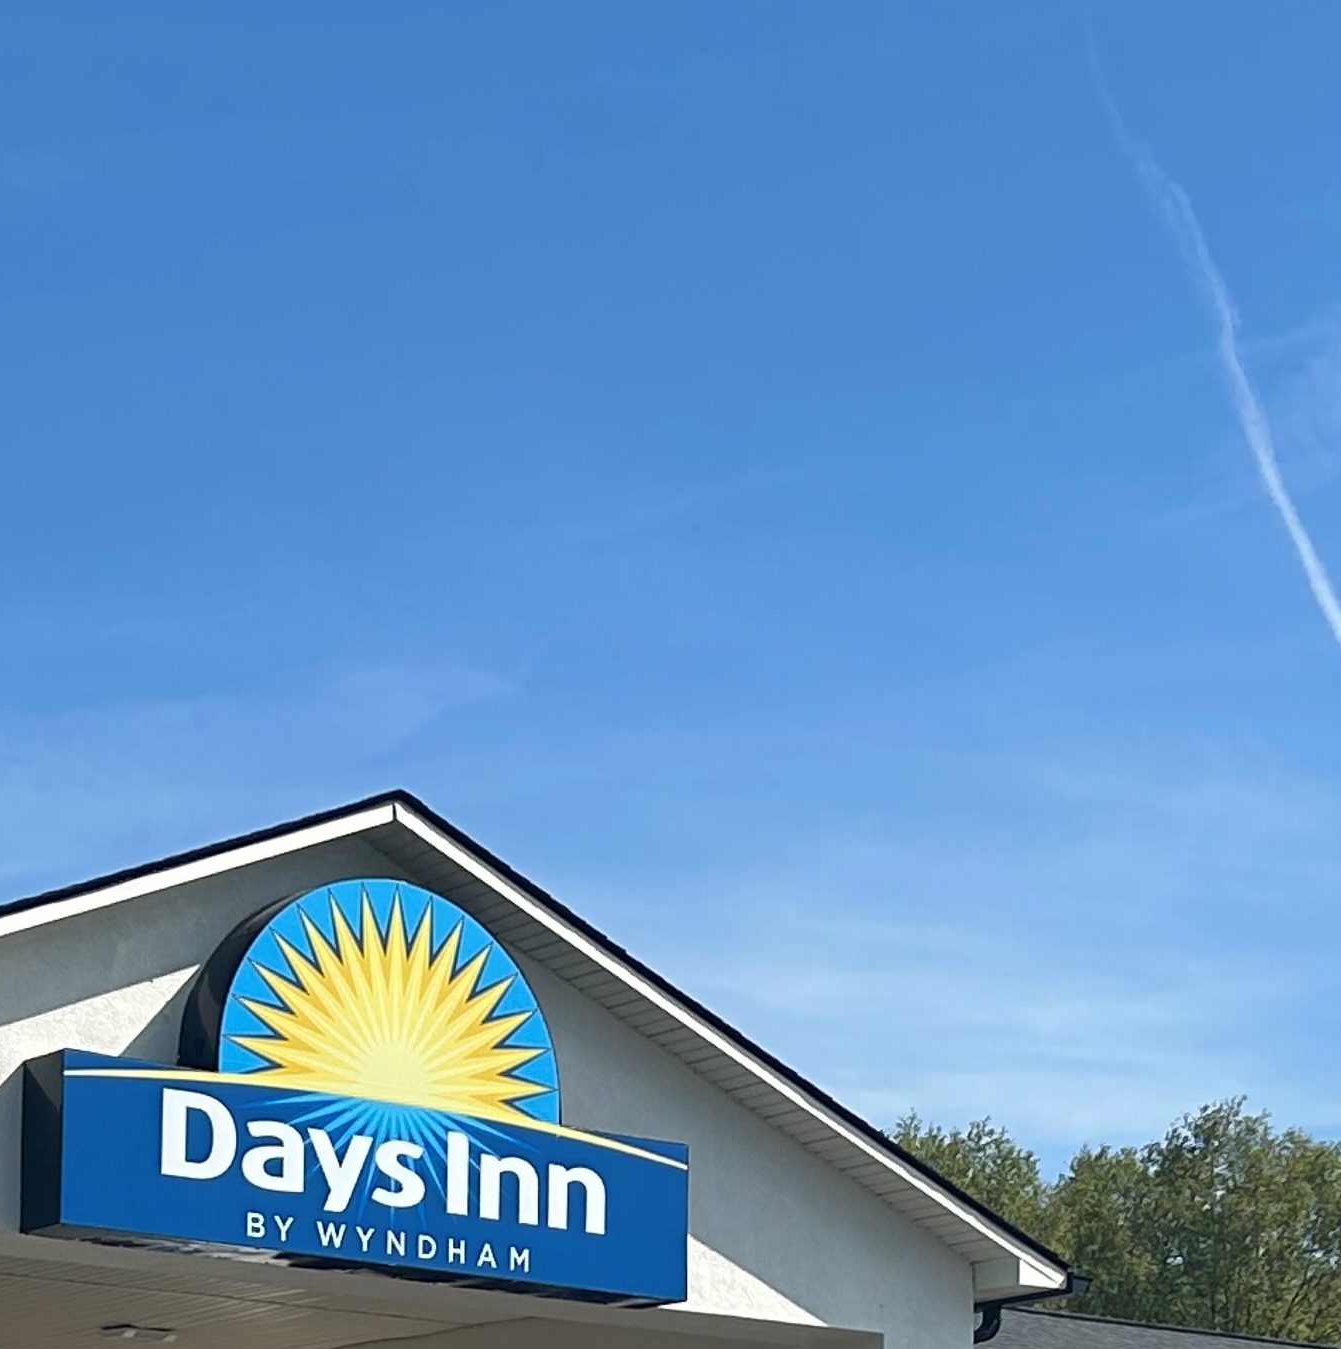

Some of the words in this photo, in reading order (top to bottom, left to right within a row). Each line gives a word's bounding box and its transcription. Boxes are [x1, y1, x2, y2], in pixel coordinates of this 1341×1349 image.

[161, 1087, 426, 1213] Days
[446, 1131, 606, 1235] Inn
[246, 1211, 295, 1242] BY
[315, 1220, 530, 1273] WYNDHAM
